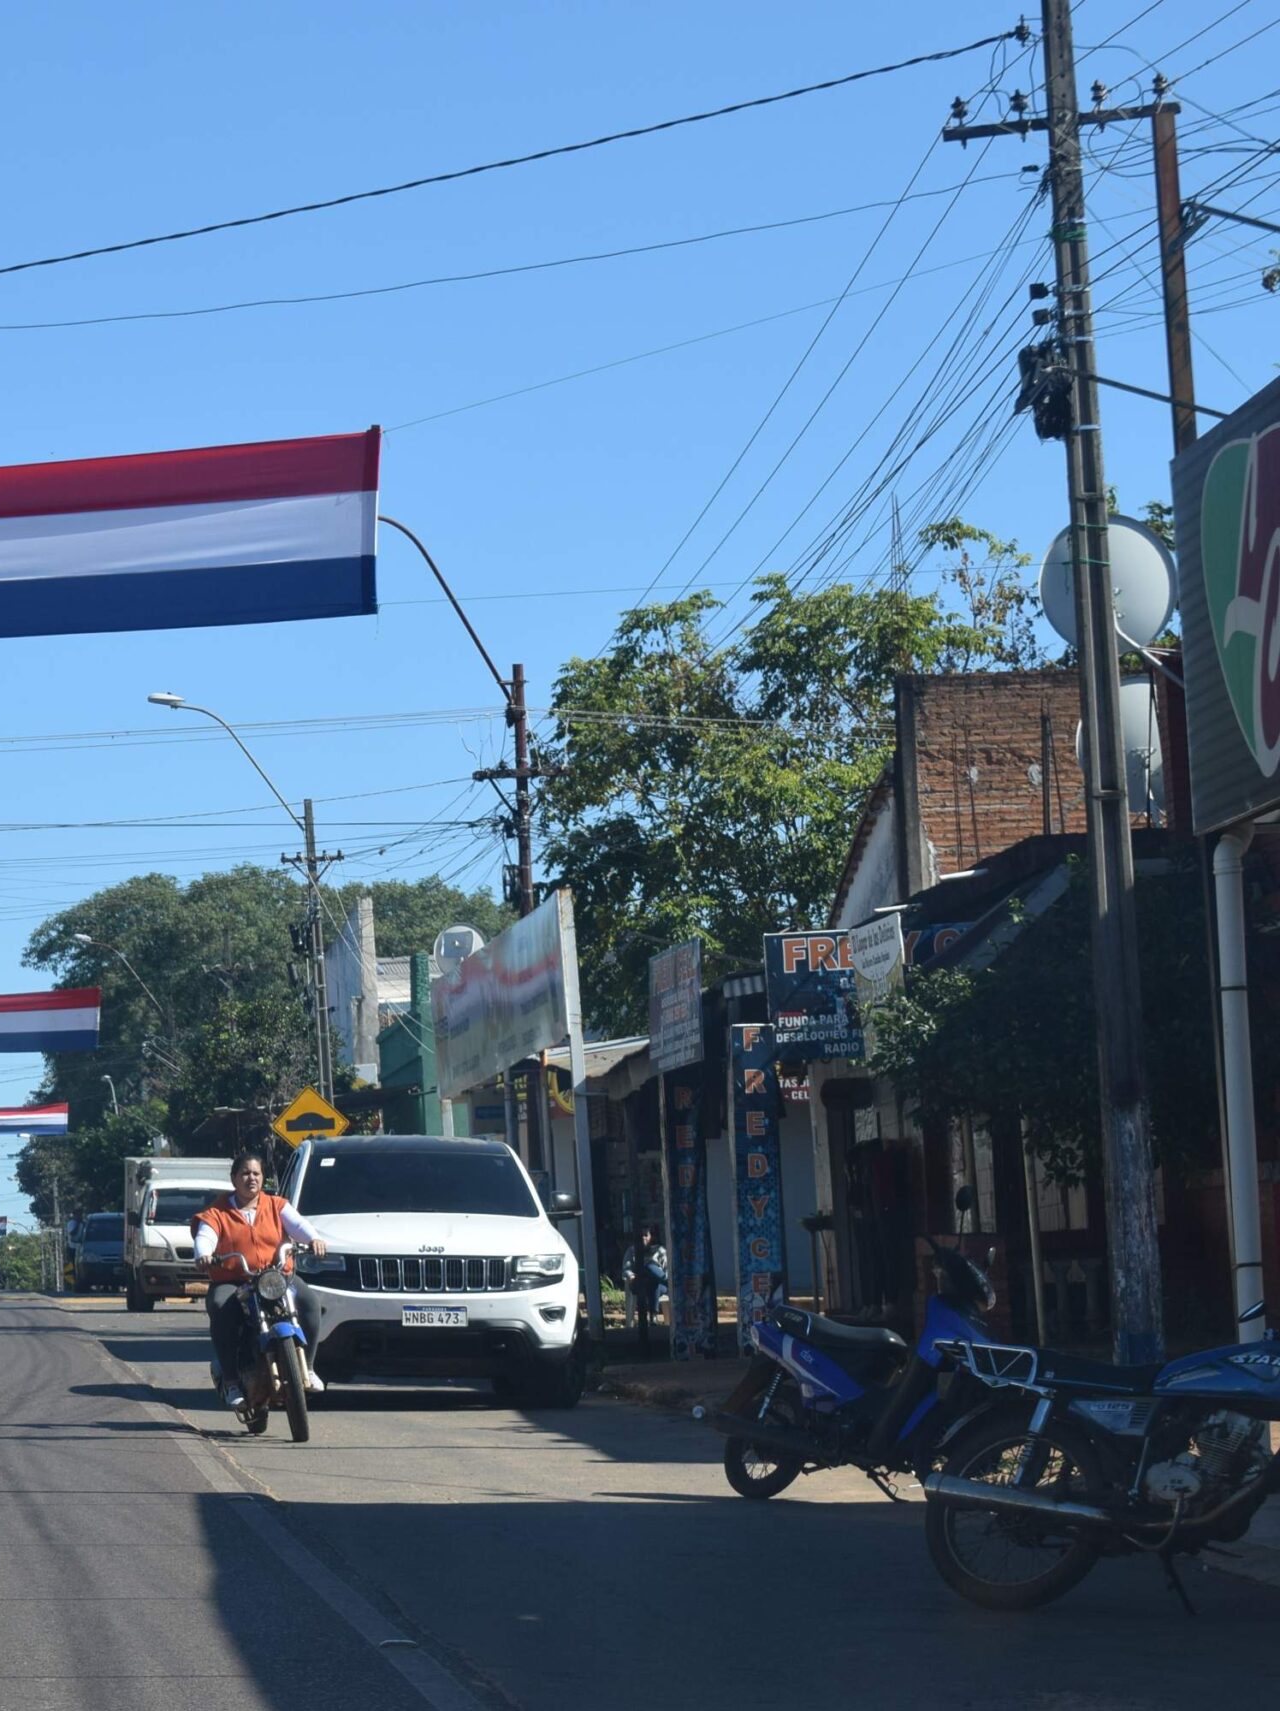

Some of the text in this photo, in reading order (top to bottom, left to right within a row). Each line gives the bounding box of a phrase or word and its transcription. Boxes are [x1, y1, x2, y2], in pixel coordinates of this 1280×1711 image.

[778, 1014, 849, 1028] FUNDA PARA
[824, 1042, 859, 1054] RADIO
[778, 1078, 798, 1088] TAS
[418, 1244, 445, 1254] Jeep
[438, 1312, 460, 1325] 473
